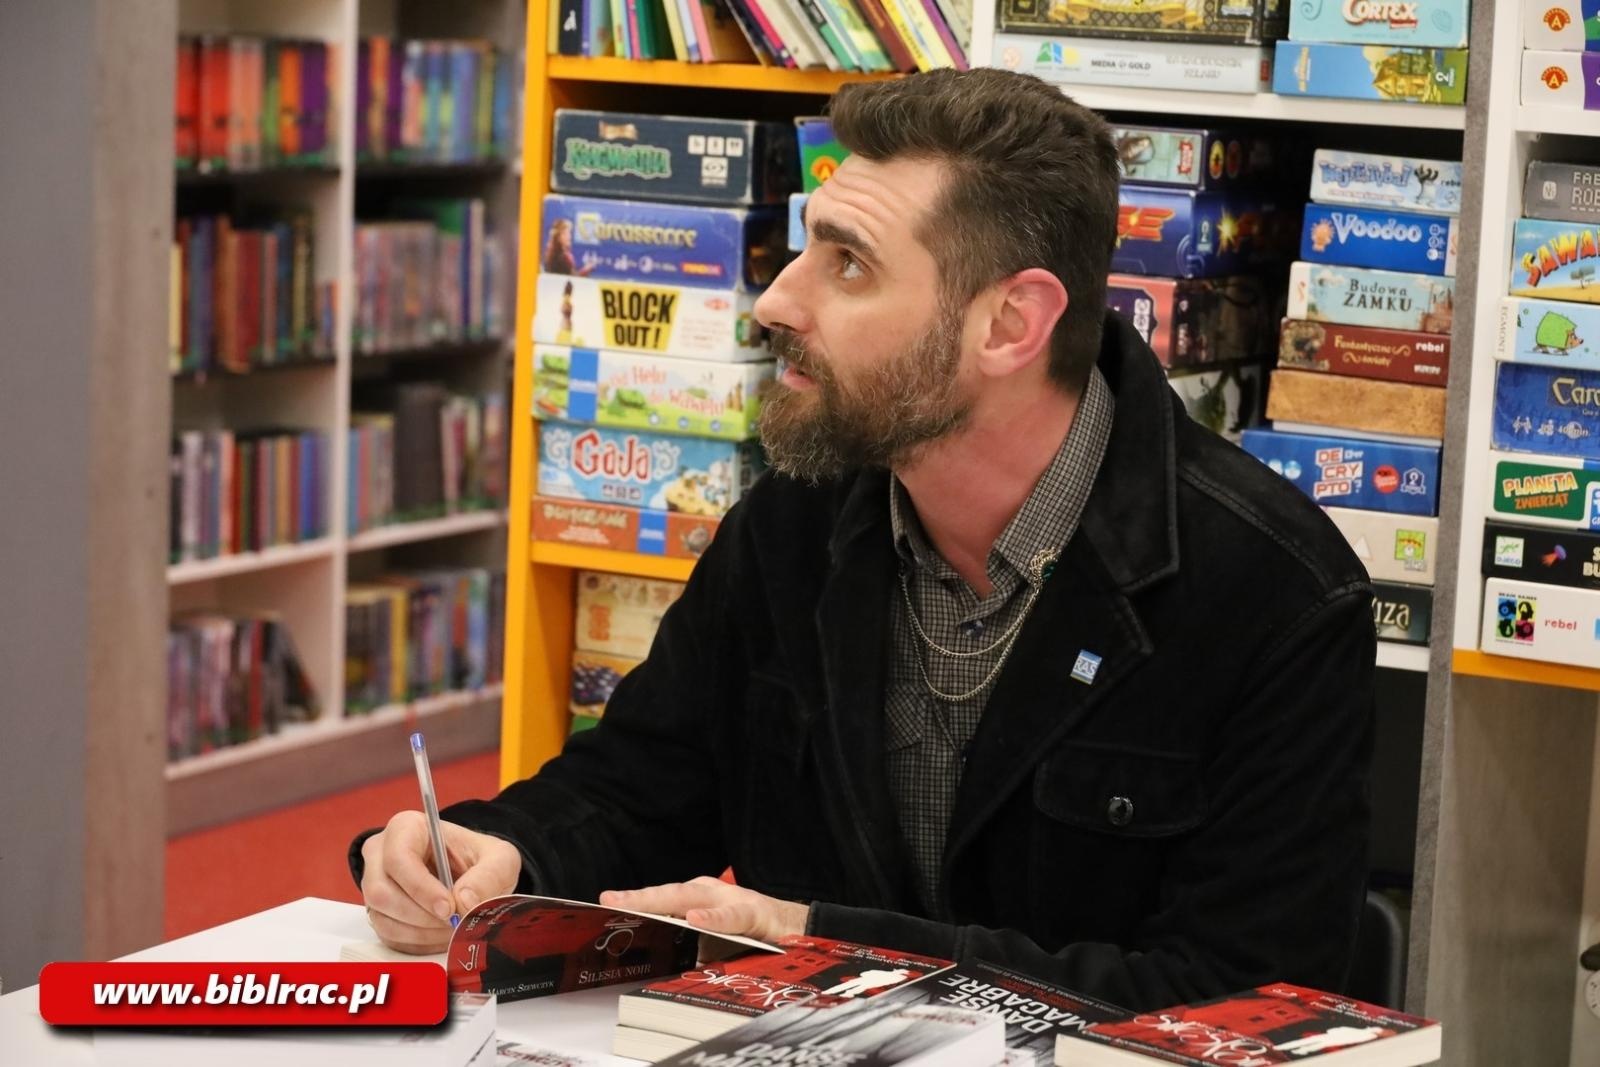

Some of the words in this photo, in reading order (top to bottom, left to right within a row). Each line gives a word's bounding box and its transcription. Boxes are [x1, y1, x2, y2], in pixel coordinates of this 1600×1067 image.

[1342, 0, 1417, 24] CORTEX
[1331, 212, 1422, 244] Voodoo
[1350, 278, 1408, 297] Budowa
[601, 289, 676, 324] BLOCK
[1343, 292, 1413, 312] ZAMKU
[1415, 341, 1445, 353] rebel
[1318, 448, 1341, 464] DE
[1324, 464, 1360, 479] CRY
[1316, 481, 1350, 496] PTO
[1503, 471, 1578, 498] PLANETA
[1514, 492, 1569, 510] ZWIERZĄT
[1544, 618, 1577, 631] rebel
[578, 969, 623, 985] SILESIA
[625, 963, 652, 977] NOIR
[487, 983, 516, 996] MARCIN
[517, 980, 555, 992] SZEWCZYK
[938, 973, 1100, 1032] MACABRE
[940, 989, 1053, 1034] DANSE
